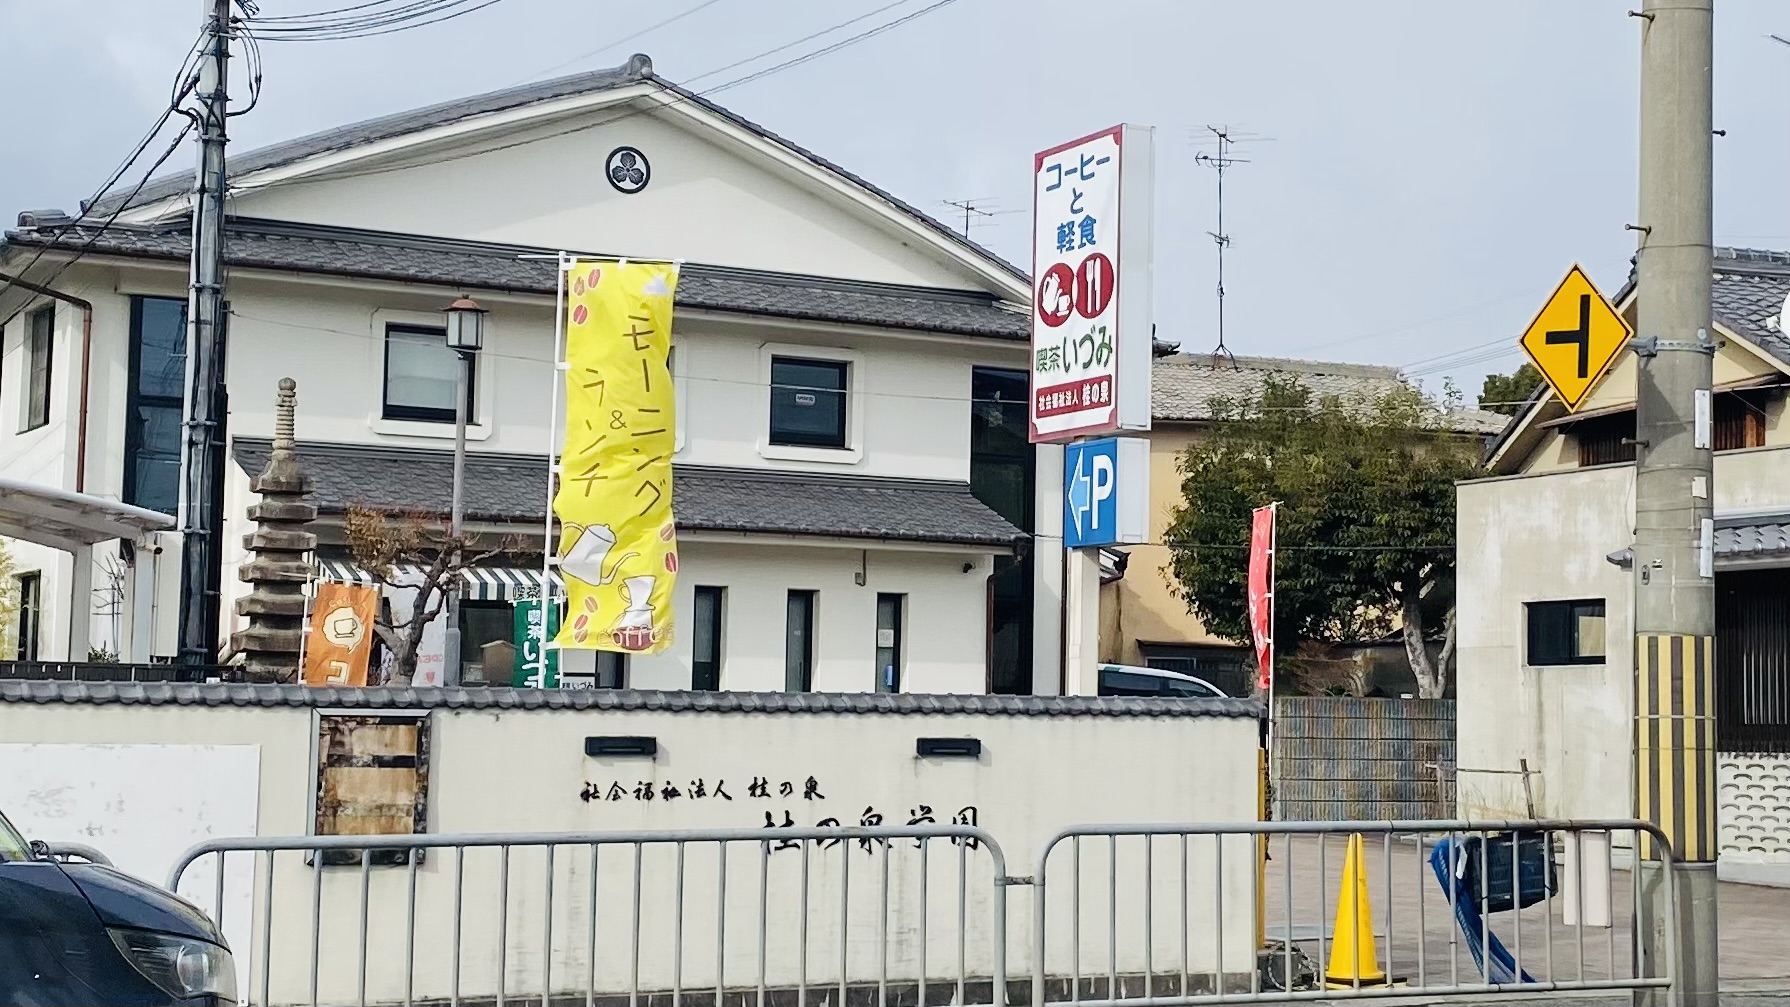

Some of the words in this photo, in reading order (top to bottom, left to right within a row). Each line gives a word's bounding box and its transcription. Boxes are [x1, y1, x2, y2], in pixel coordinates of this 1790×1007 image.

[1046, 153, 1110, 192] コーヒー
[1070, 187, 1083, 214] と
[1056, 214, 1096, 254] 軽食
[1036, 324, 1113, 374] 喫茶いづみ
[622, 312, 667, 517] モーニング
[1038, 388, 1079, 412] 社会福祉法人
[1082, 380, 1109, 406] 桂の泉
[570, 367, 609, 498] ランチ
[609, 409, 628, 430] &
[1091, 454, 1113, 530] P
[580, 778, 733, 802] 社会福祉法人
[748, 775, 826, 801] 桂の泉
